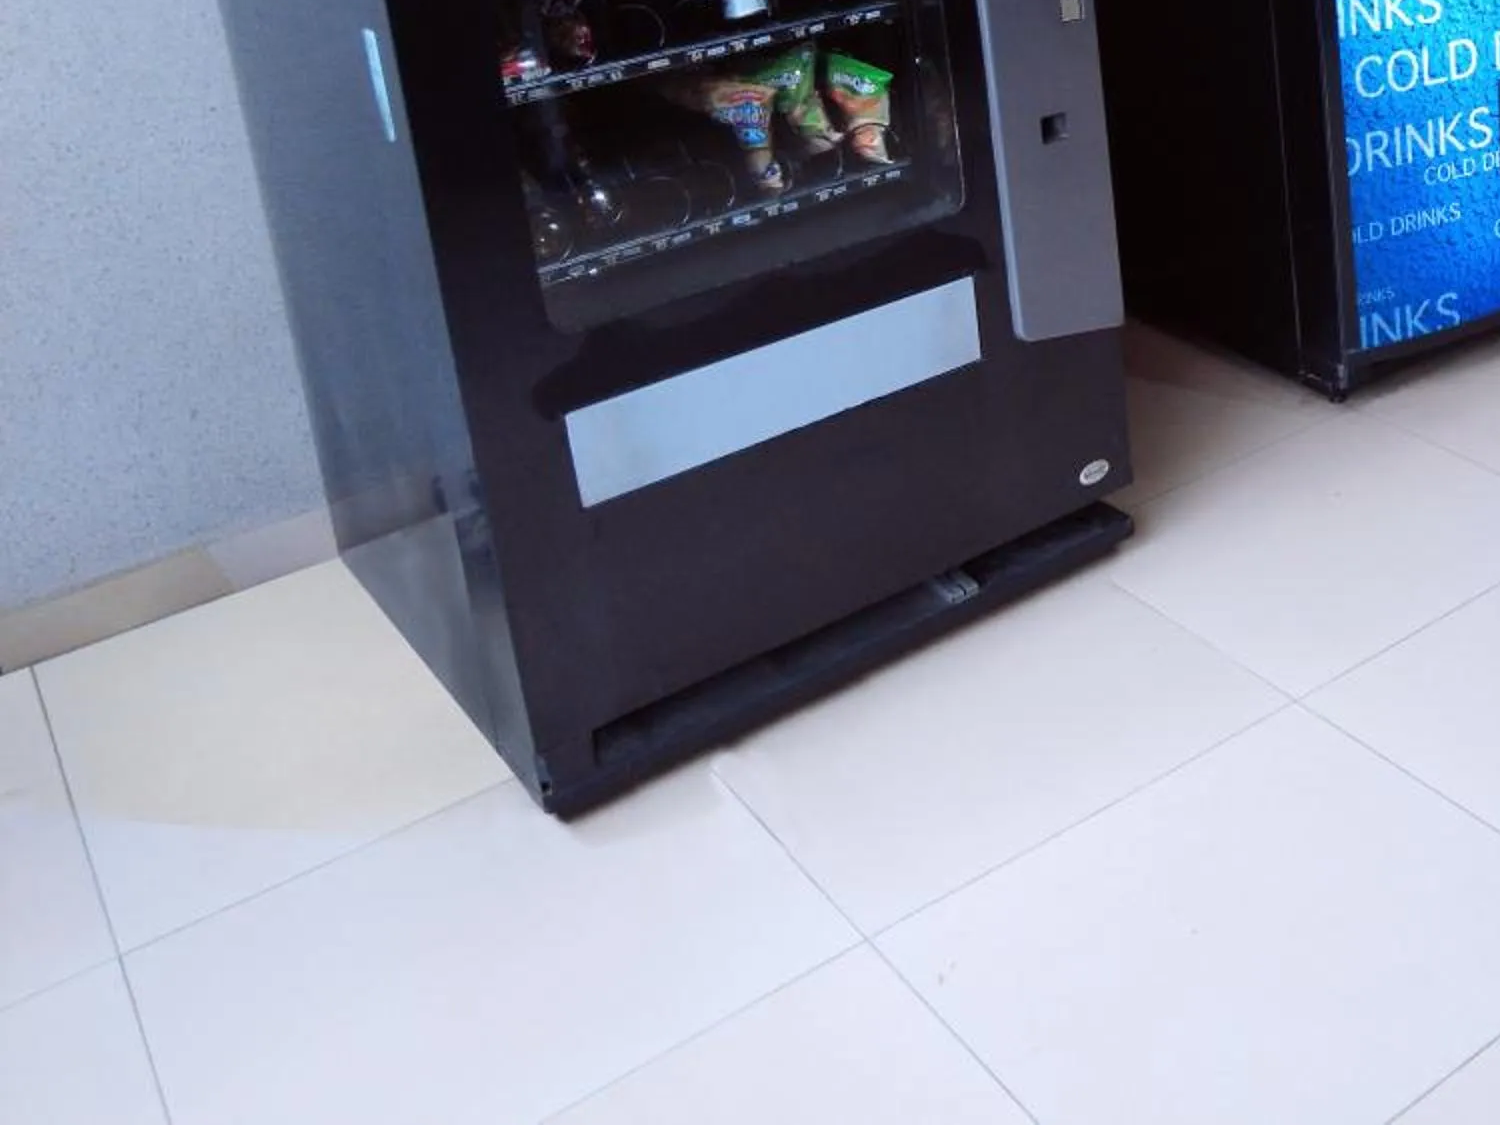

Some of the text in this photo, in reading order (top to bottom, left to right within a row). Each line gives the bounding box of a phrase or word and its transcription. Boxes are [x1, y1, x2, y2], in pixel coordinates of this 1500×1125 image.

[1355, 38, 1478, 98] COLD
[1423, 157, 1476, 186] COLD
[1352, 202, 1461, 244] LD DRINKS
[1360, 292, 1461, 350] INKS
